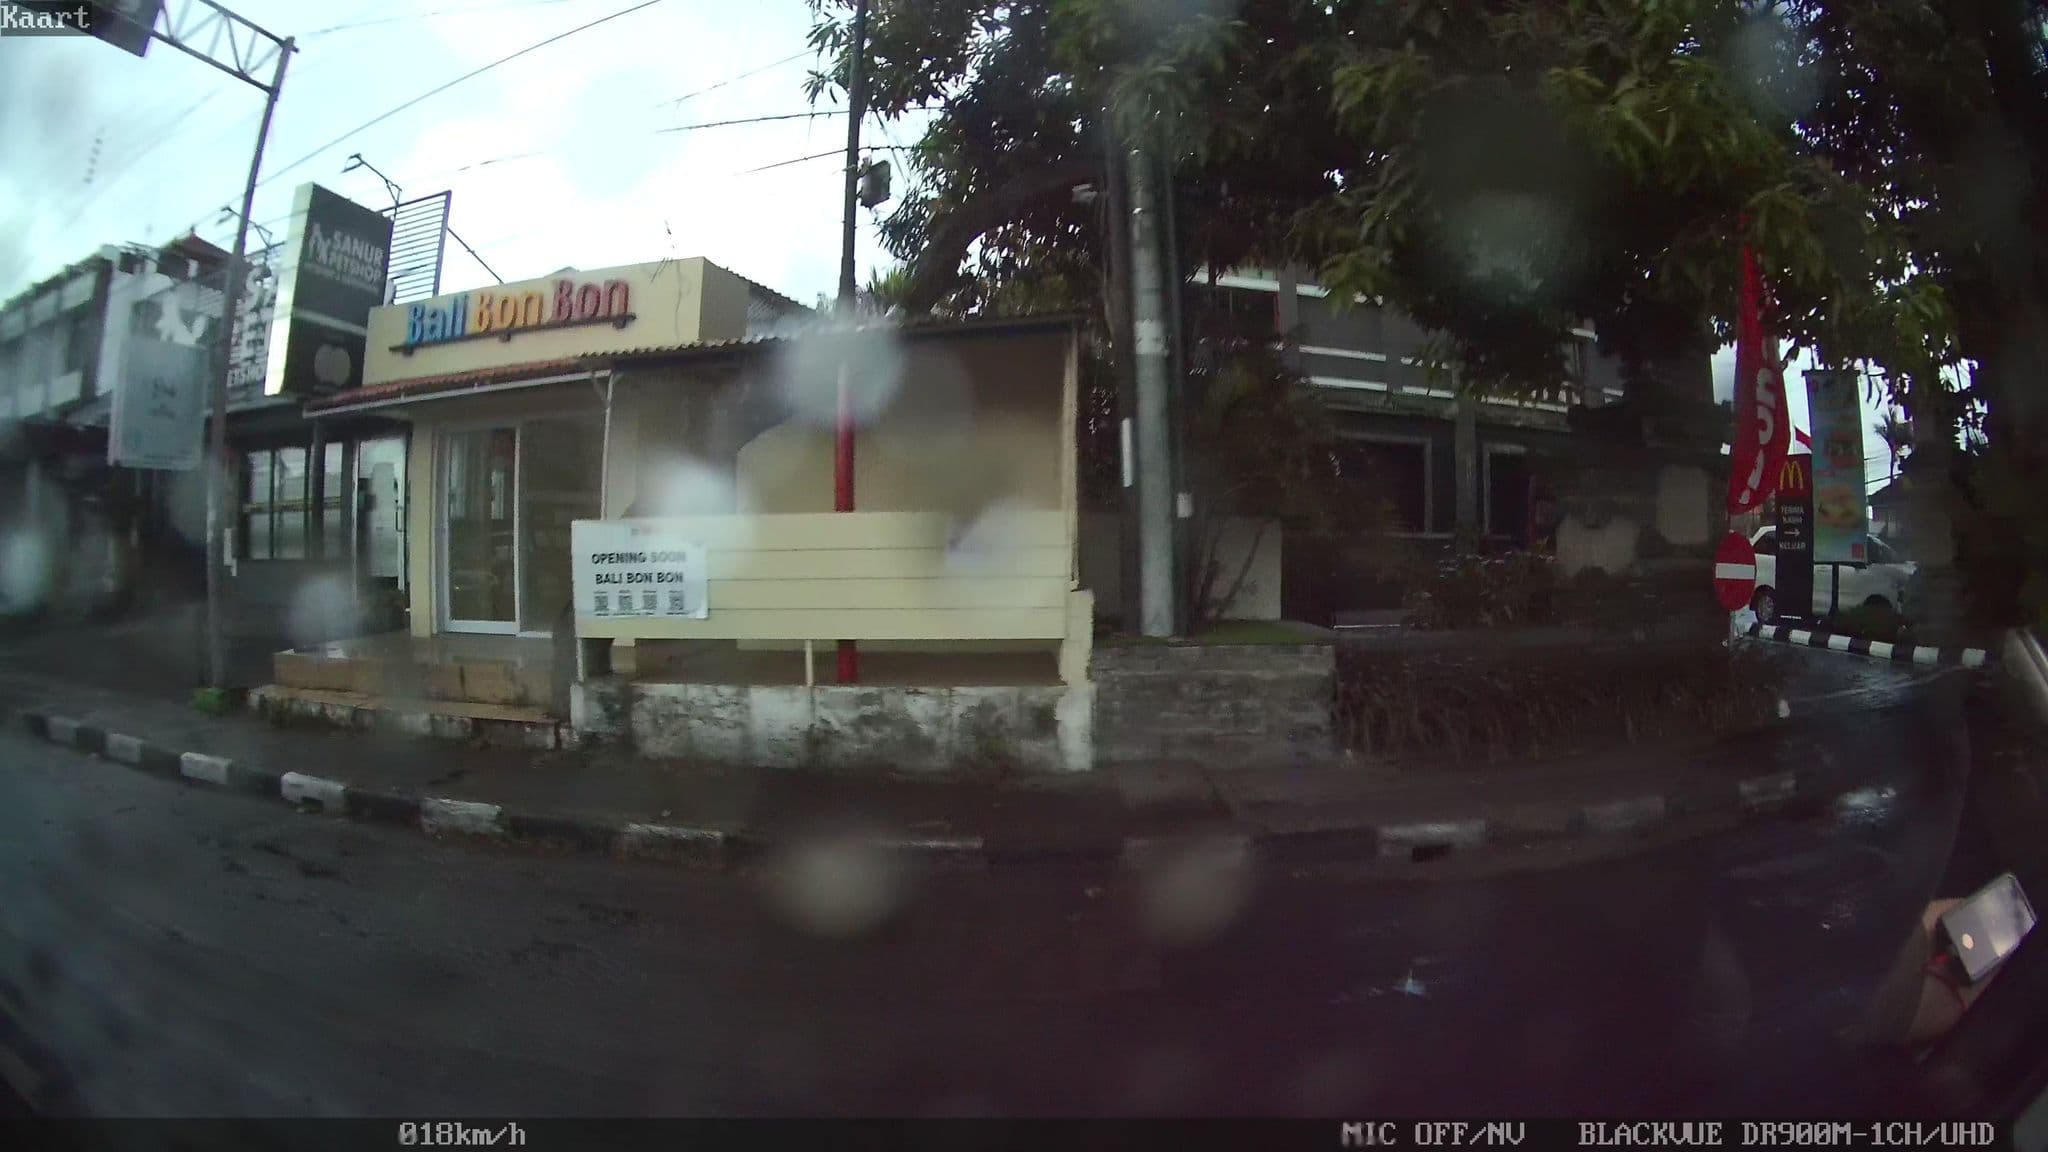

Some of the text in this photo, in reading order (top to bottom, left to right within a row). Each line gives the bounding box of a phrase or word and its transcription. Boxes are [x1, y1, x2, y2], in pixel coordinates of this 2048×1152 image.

[332, 230, 384, 268] SANUR
[470, 290, 545, 334] Bon
[550, 278, 630, 322] Bon
[592, 551, 686, 564] OPENING SOON
[595, 571, 684, 584] BALI BON BON
